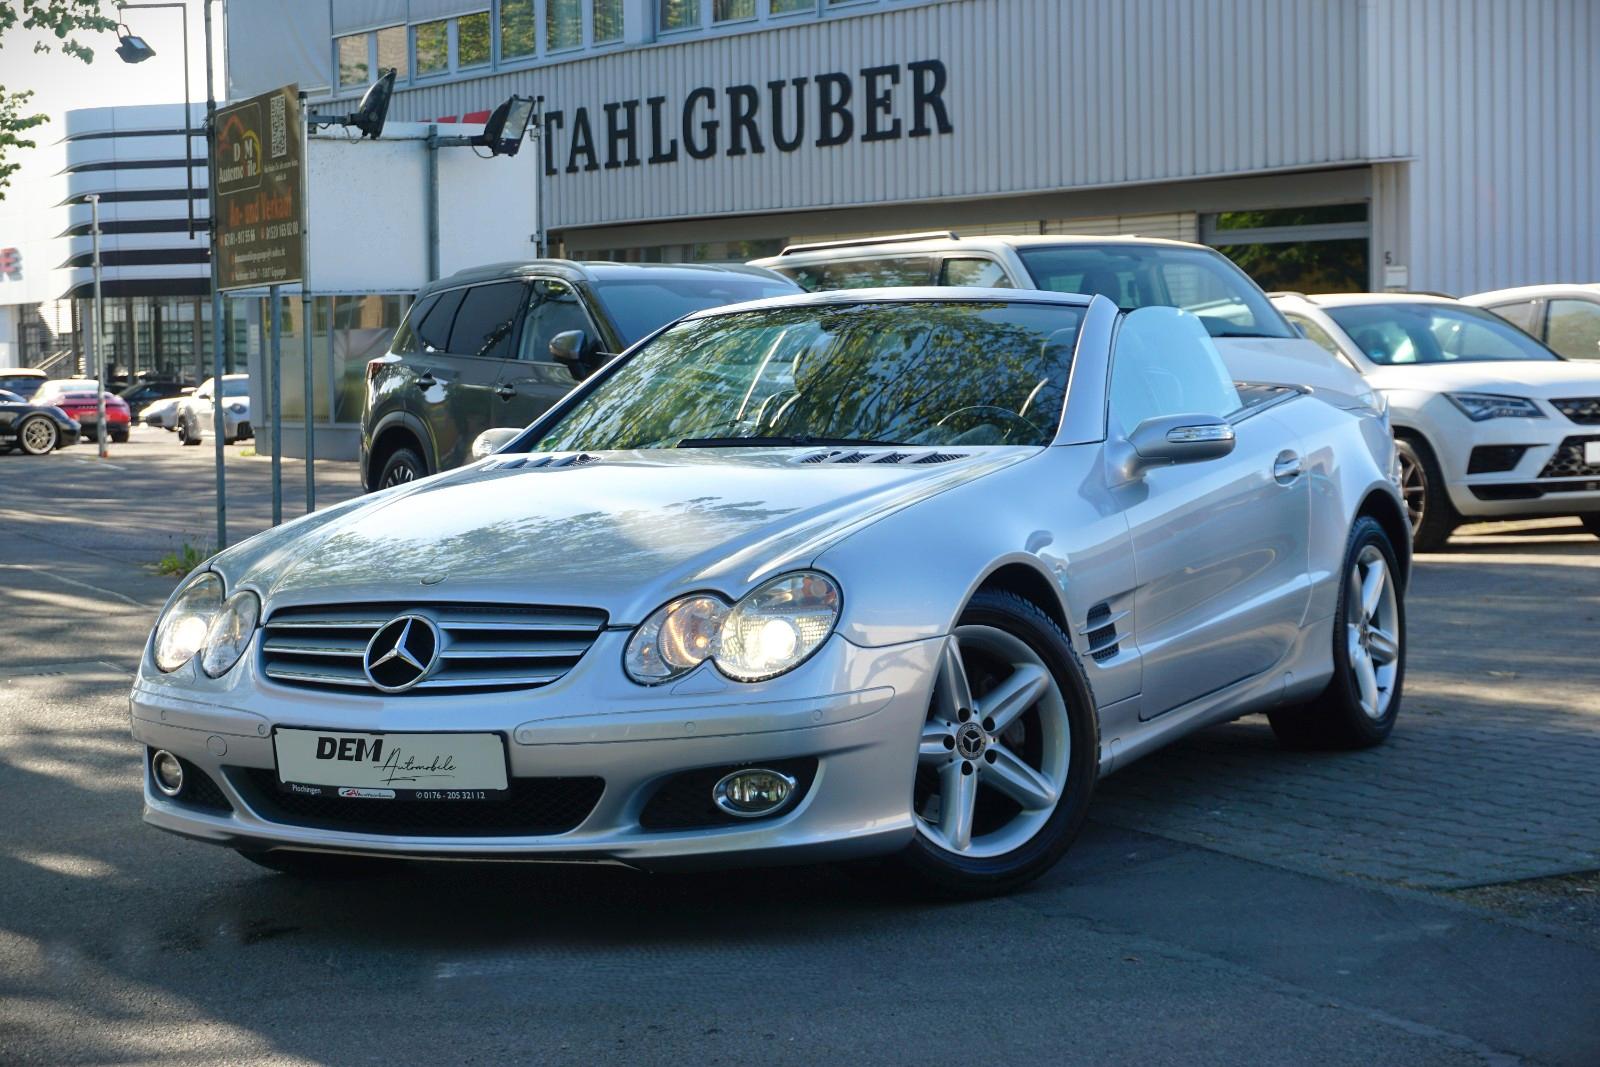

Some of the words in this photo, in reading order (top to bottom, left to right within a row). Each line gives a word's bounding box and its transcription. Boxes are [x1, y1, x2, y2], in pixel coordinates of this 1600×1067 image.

[316, 736, 384, 762] DEM
[374, 747, 457, 785] Automobile
[424, 791, 441, 799] 0176
[447, 791, 461, 799] 205
[462, 791, 474, 800] 321
[476, 791, 486, 799] 12
